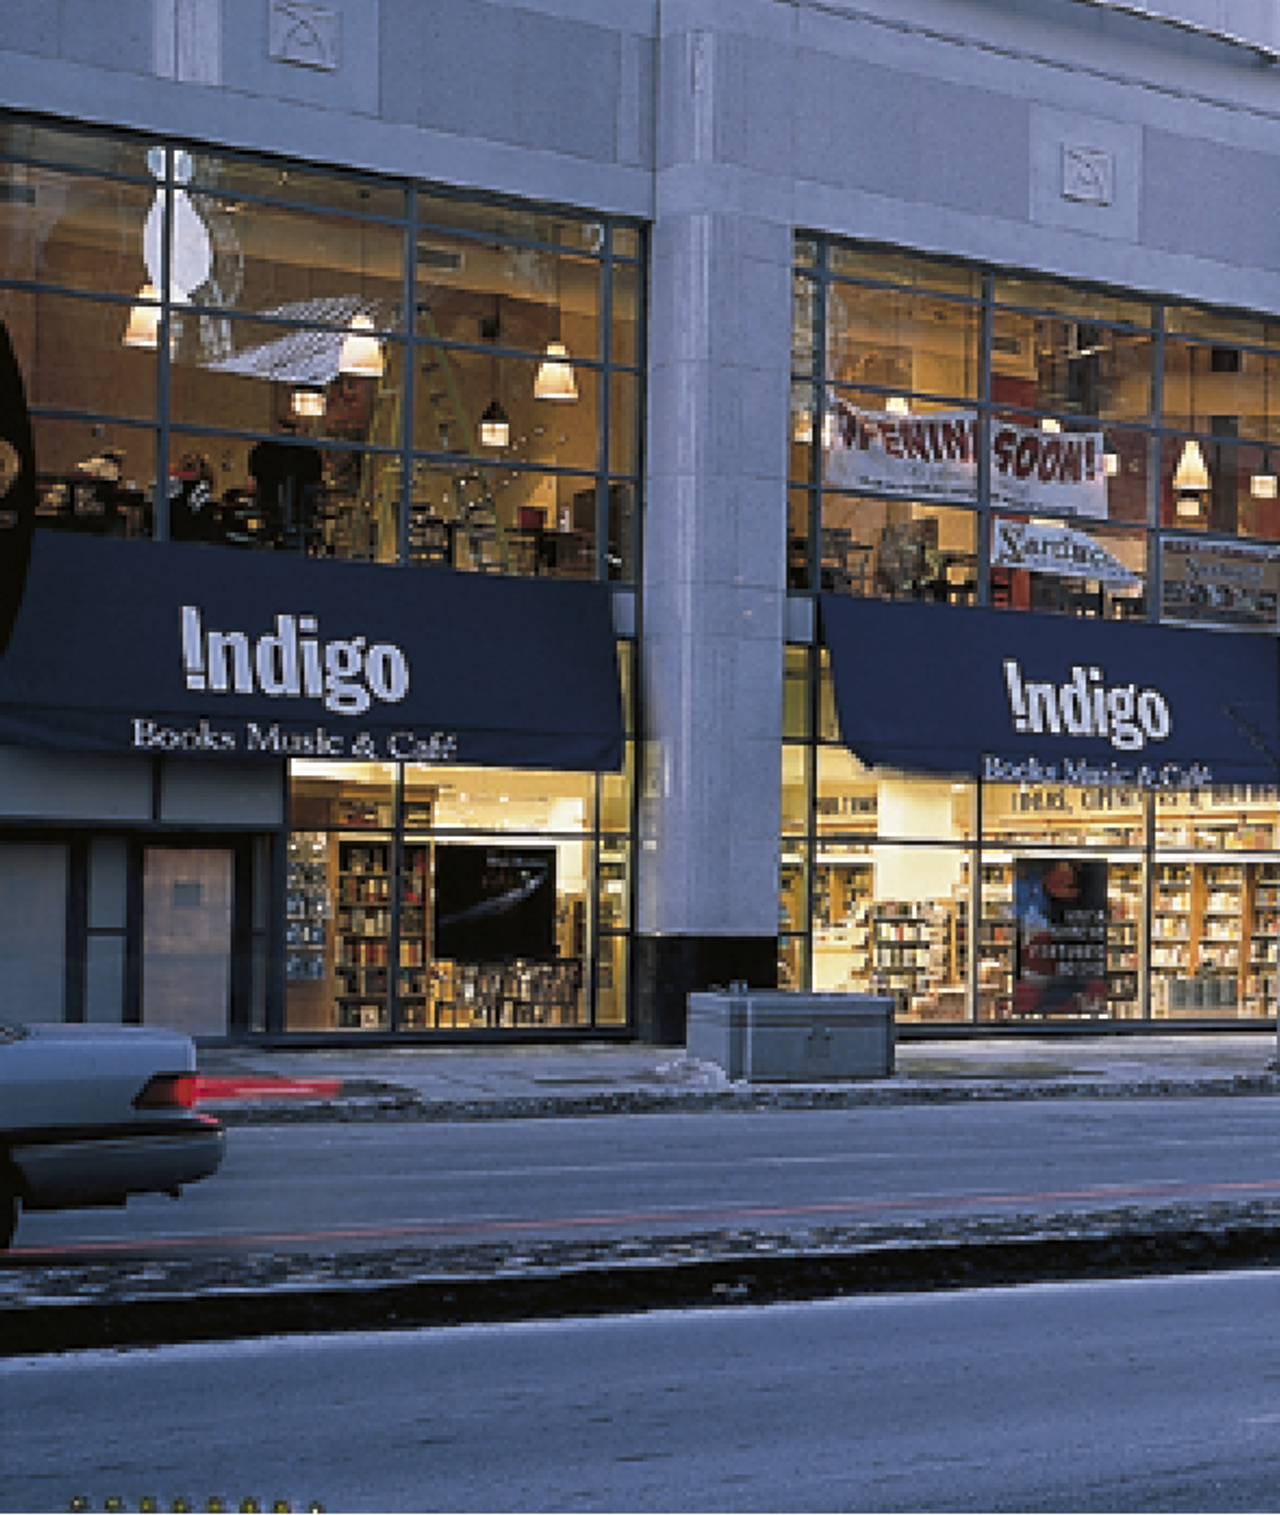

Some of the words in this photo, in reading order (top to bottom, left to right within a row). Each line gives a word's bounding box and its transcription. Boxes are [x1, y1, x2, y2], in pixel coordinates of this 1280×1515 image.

[837, 401, 979, 463] OPENIN
[993, 429, 1096, 483] SOON!
[131, 717, 236, 751] Books
[246, 722, 345, 757] Music
[350, 734, 377, 760] &
[387, 731, 459, 762] Café
[983, 755, 1057, 784] Books
[1062, 759, 1130, 785] Music
